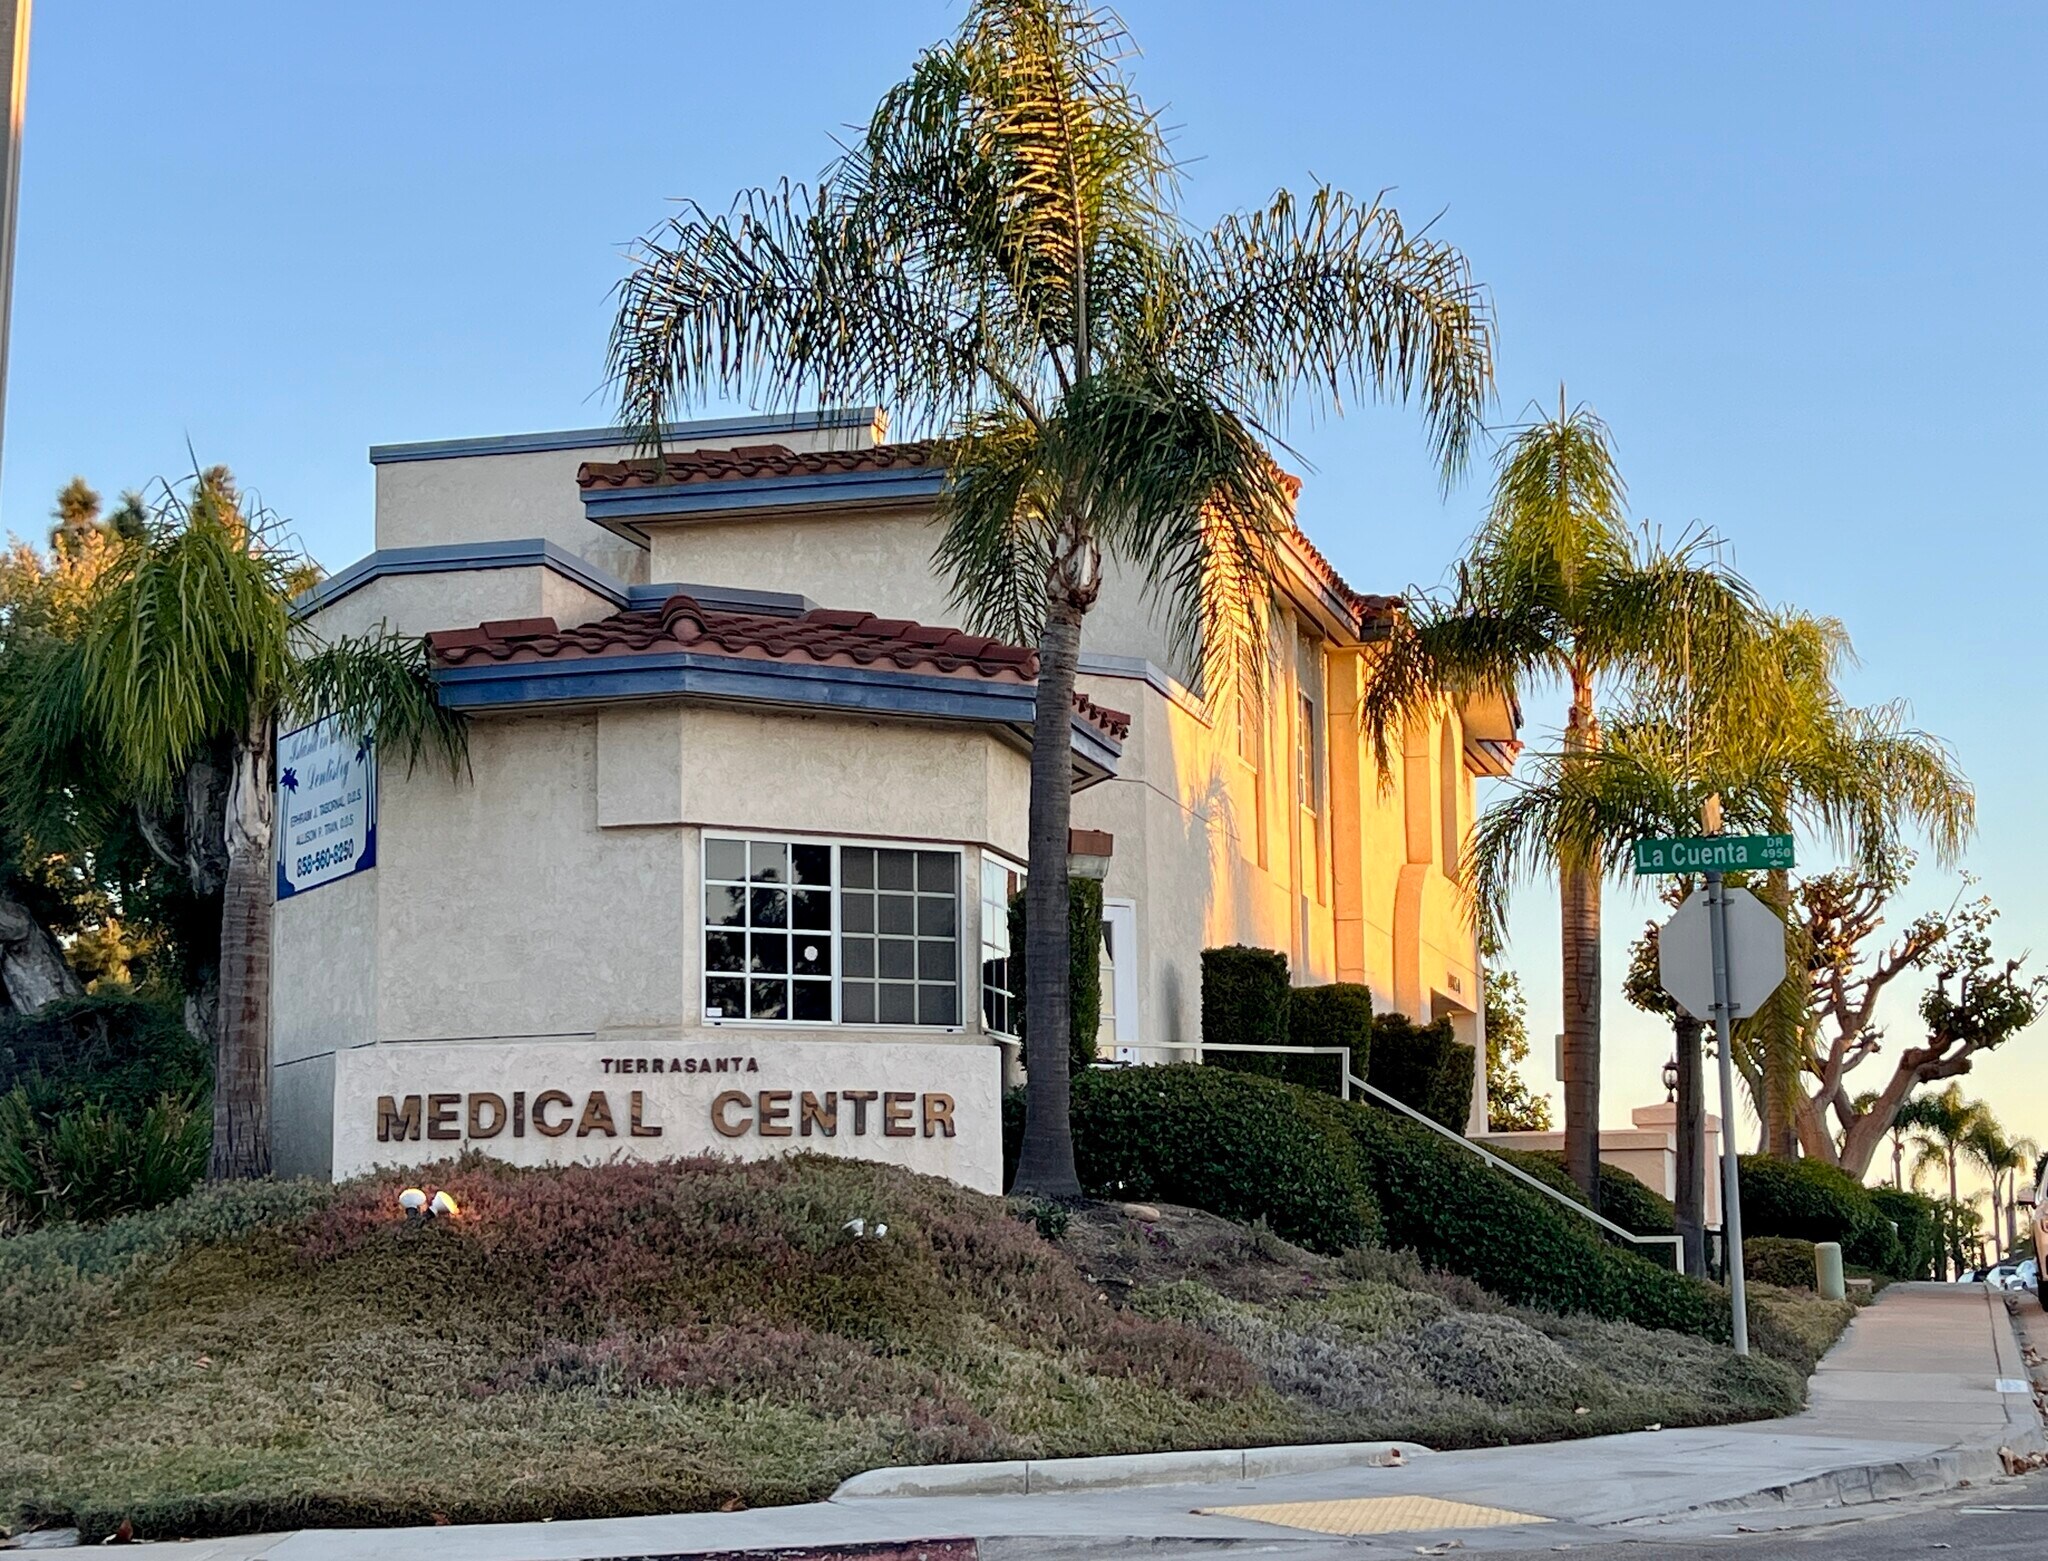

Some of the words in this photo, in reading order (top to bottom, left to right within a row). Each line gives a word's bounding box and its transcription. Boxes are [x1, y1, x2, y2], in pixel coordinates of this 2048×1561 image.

[1766, 837, 1784, 848] DR
[1638, 844, 1664, 868] La
[1671, 842, 1748, 866] Cuenta
[1760, 848, 1791, 858] 4950
[601, 1056, 760, 1074] TIERRASANTA
[377, 1090, 662, 1141] MEDICAL
[711, 1091, 957, 1139] CENTER
